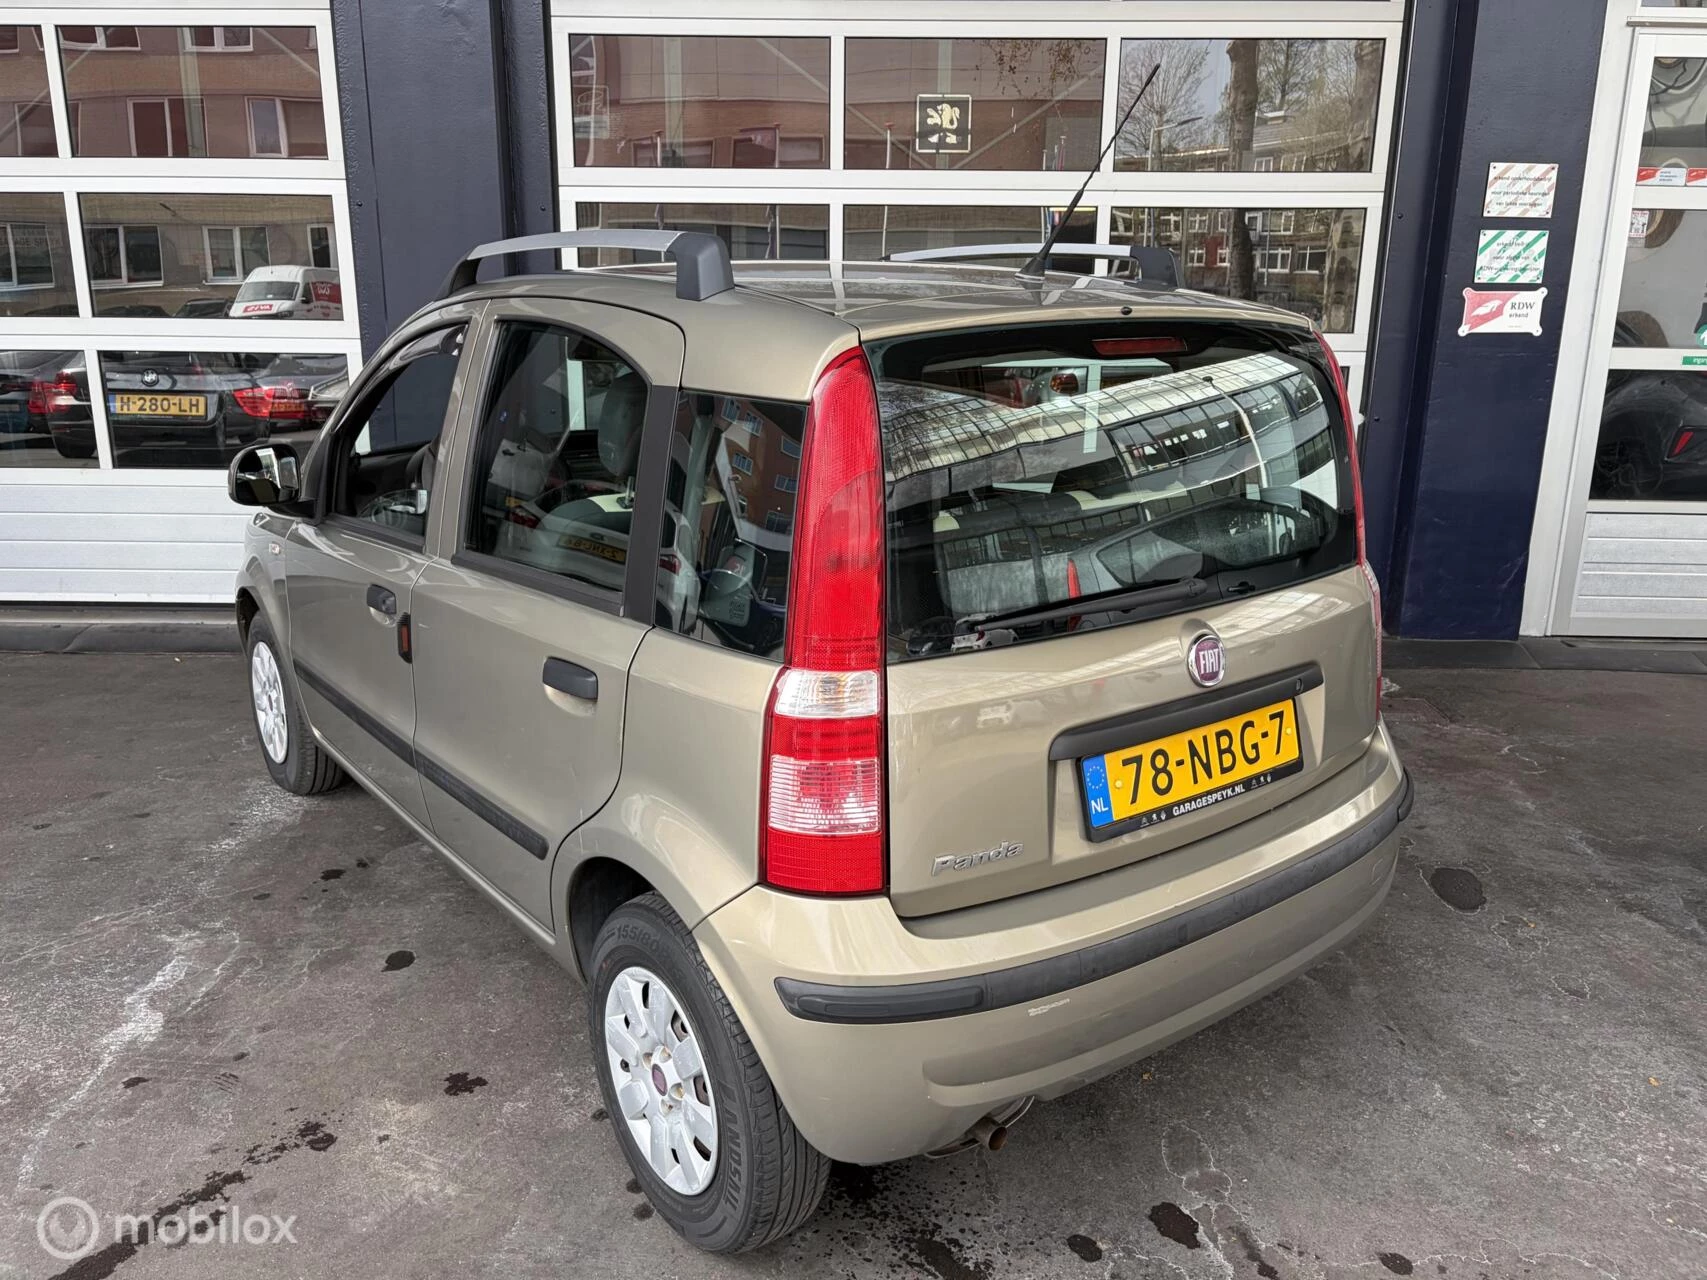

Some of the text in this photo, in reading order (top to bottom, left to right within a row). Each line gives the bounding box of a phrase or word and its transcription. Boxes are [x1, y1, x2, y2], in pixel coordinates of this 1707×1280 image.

[1510, 301, 1535, 311] RDW
[119, 396, 200, 413] H-280-LH
[1198, 648, 1219, 675] FIAT
[1121, 709, 1285, 805] 78-NBG-7
[1090, 796, 1109, 815] NL
[1172, 783, 1246, 817] GARAGESPEYK.NL
[931, 840, 1024, 877] Panda
